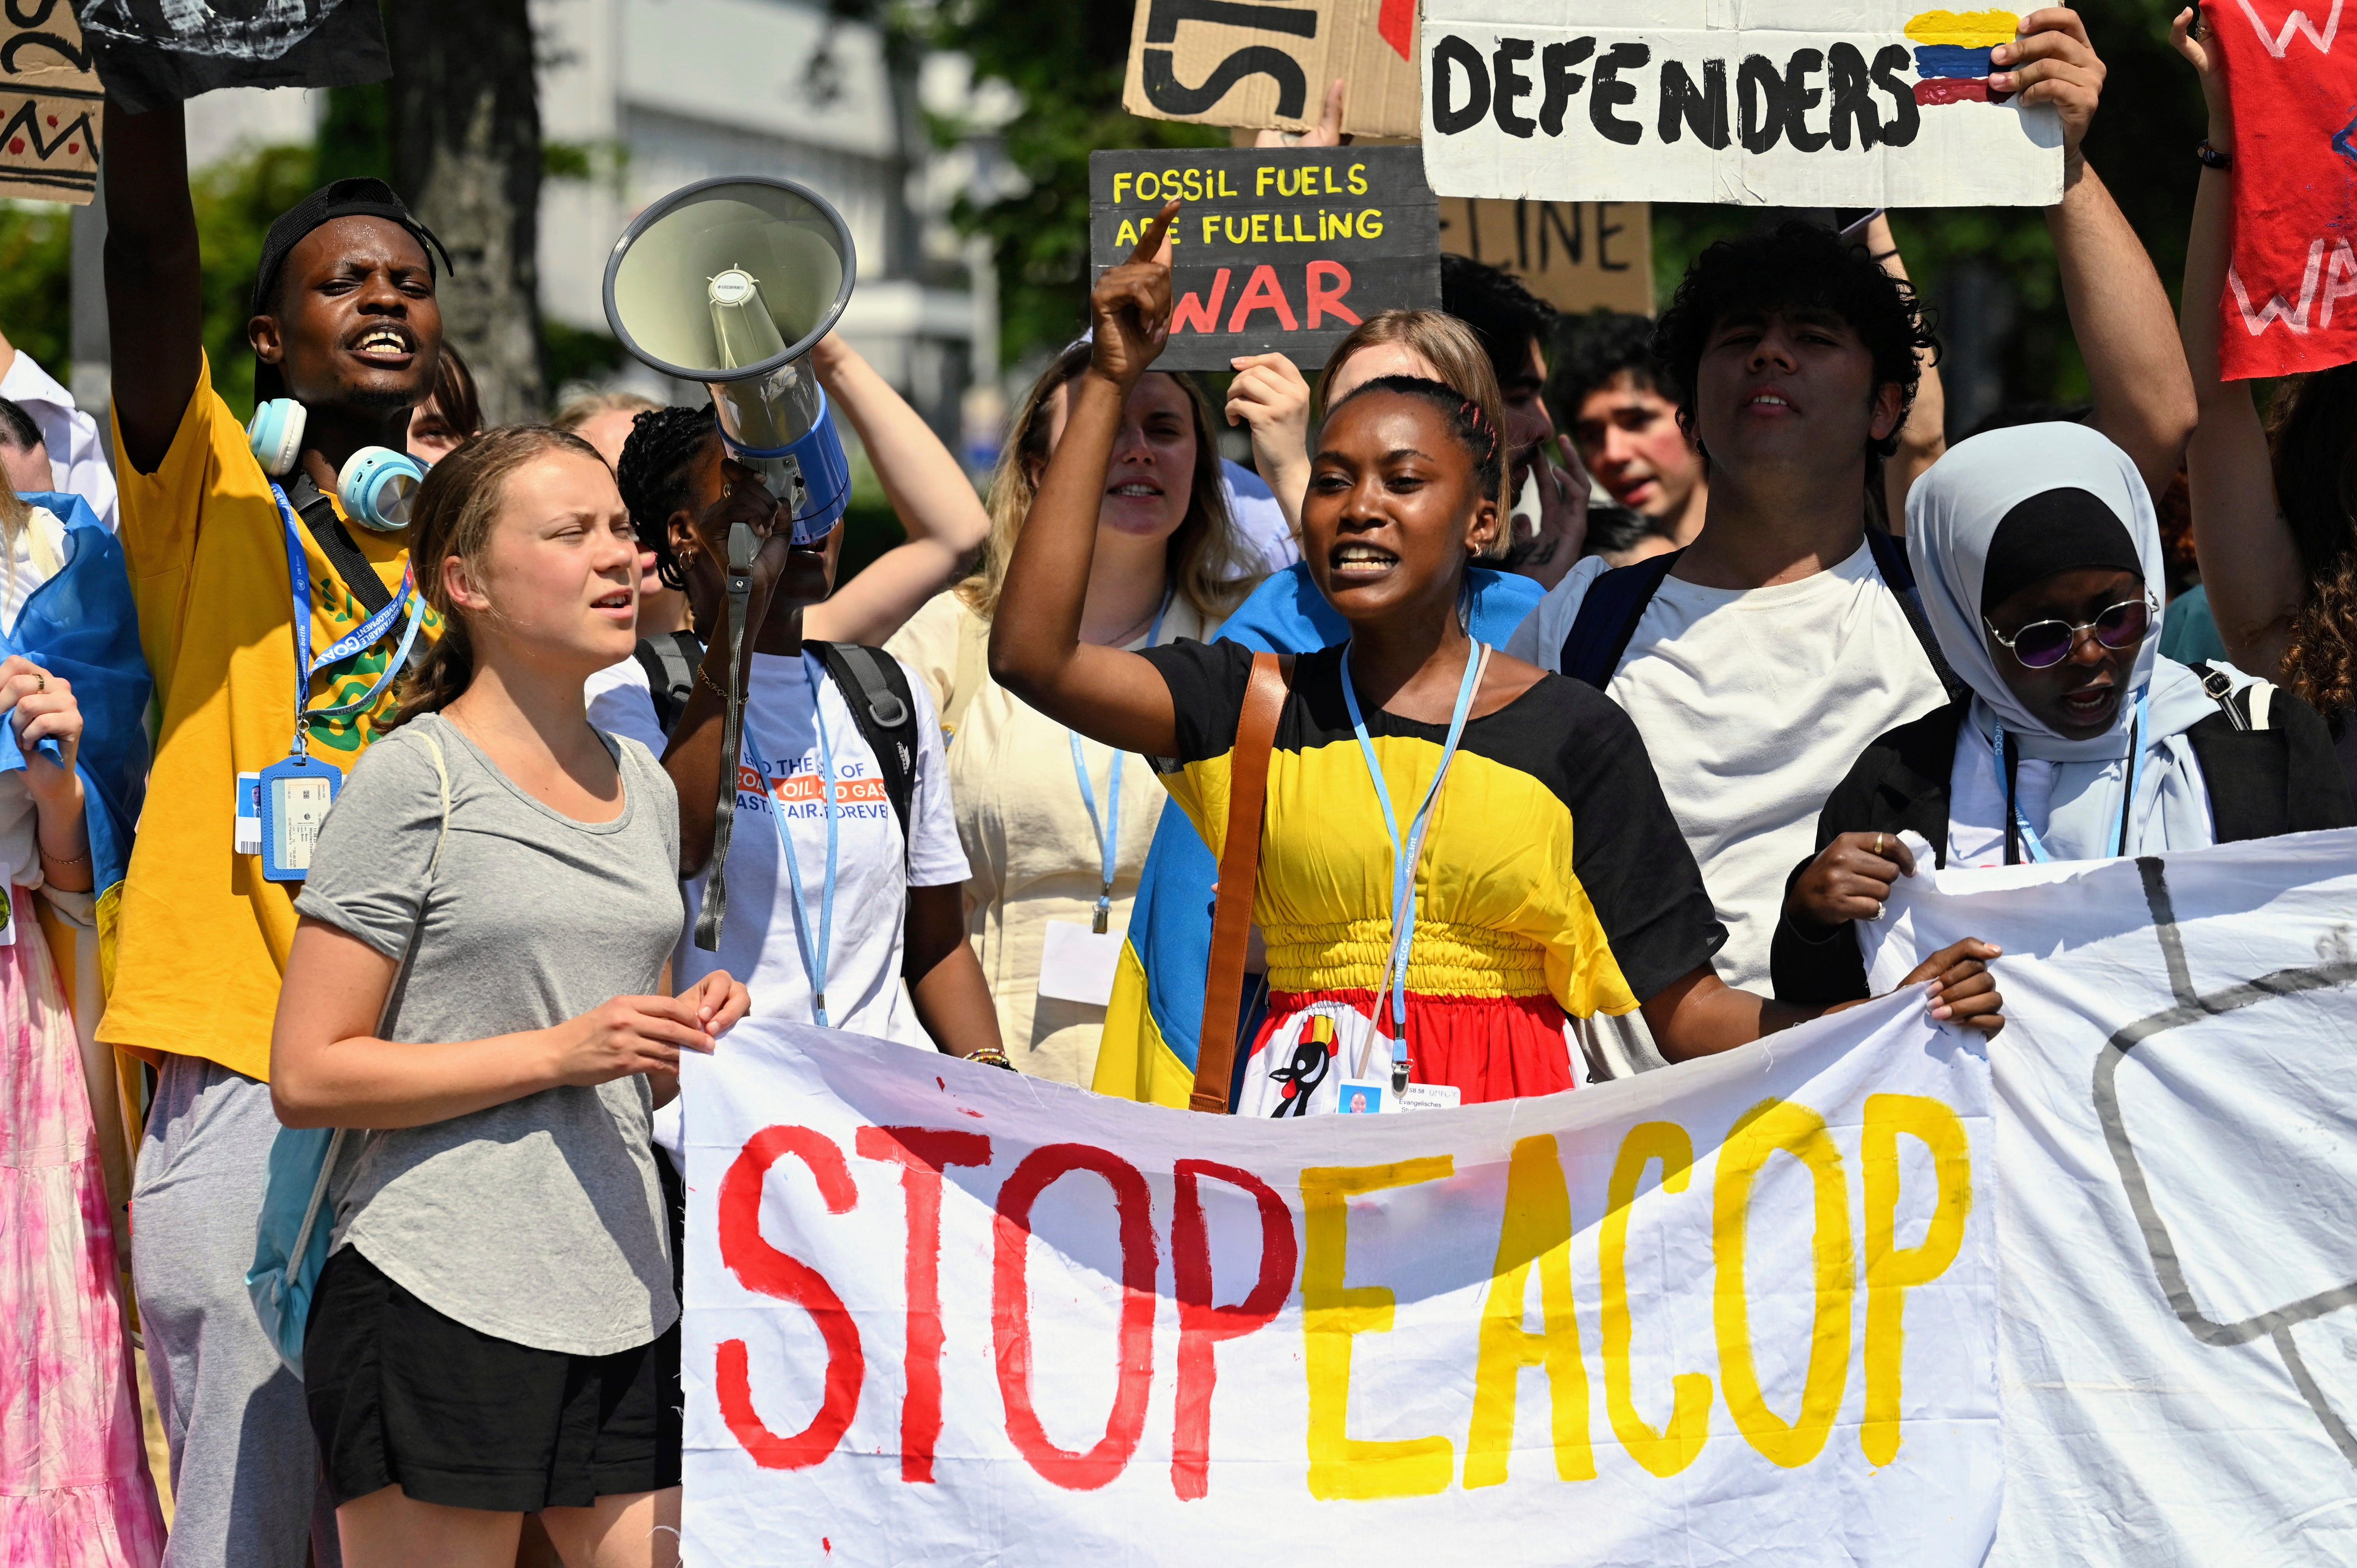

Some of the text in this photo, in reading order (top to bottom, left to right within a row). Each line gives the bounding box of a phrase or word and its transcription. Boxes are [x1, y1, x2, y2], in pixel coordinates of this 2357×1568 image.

[1432, 35, 1920, 155] DEFENDERS
[1256, 163, 1368, 197] FUELS
[1115, 217, 1181, 247] AE
[1170, 260, 1363, 334] WAR
[356, 600, 398, 638] DEVELOPMENT
[360, 607, 399, 645] SUSTAINABLE
[1995, 722, 2003, 755] NFCCC
[776, 758, 813, 775] THE
[841, 763, 864, 778] OF
[736, 794, 773, 815] AST.
[780, 803, 823, 817] AIR.
[783, 781, 813, 797] OIL
[852, 782, 886, 798] GAS
[1406, 837, 1417, 879] fccc.int
[1395, 938, 1410, 982] UNFCCC
[1399, 1098, 1442, 1108] Evangelisches
[716, 1093, 1972, 1501] STOP EACOP
